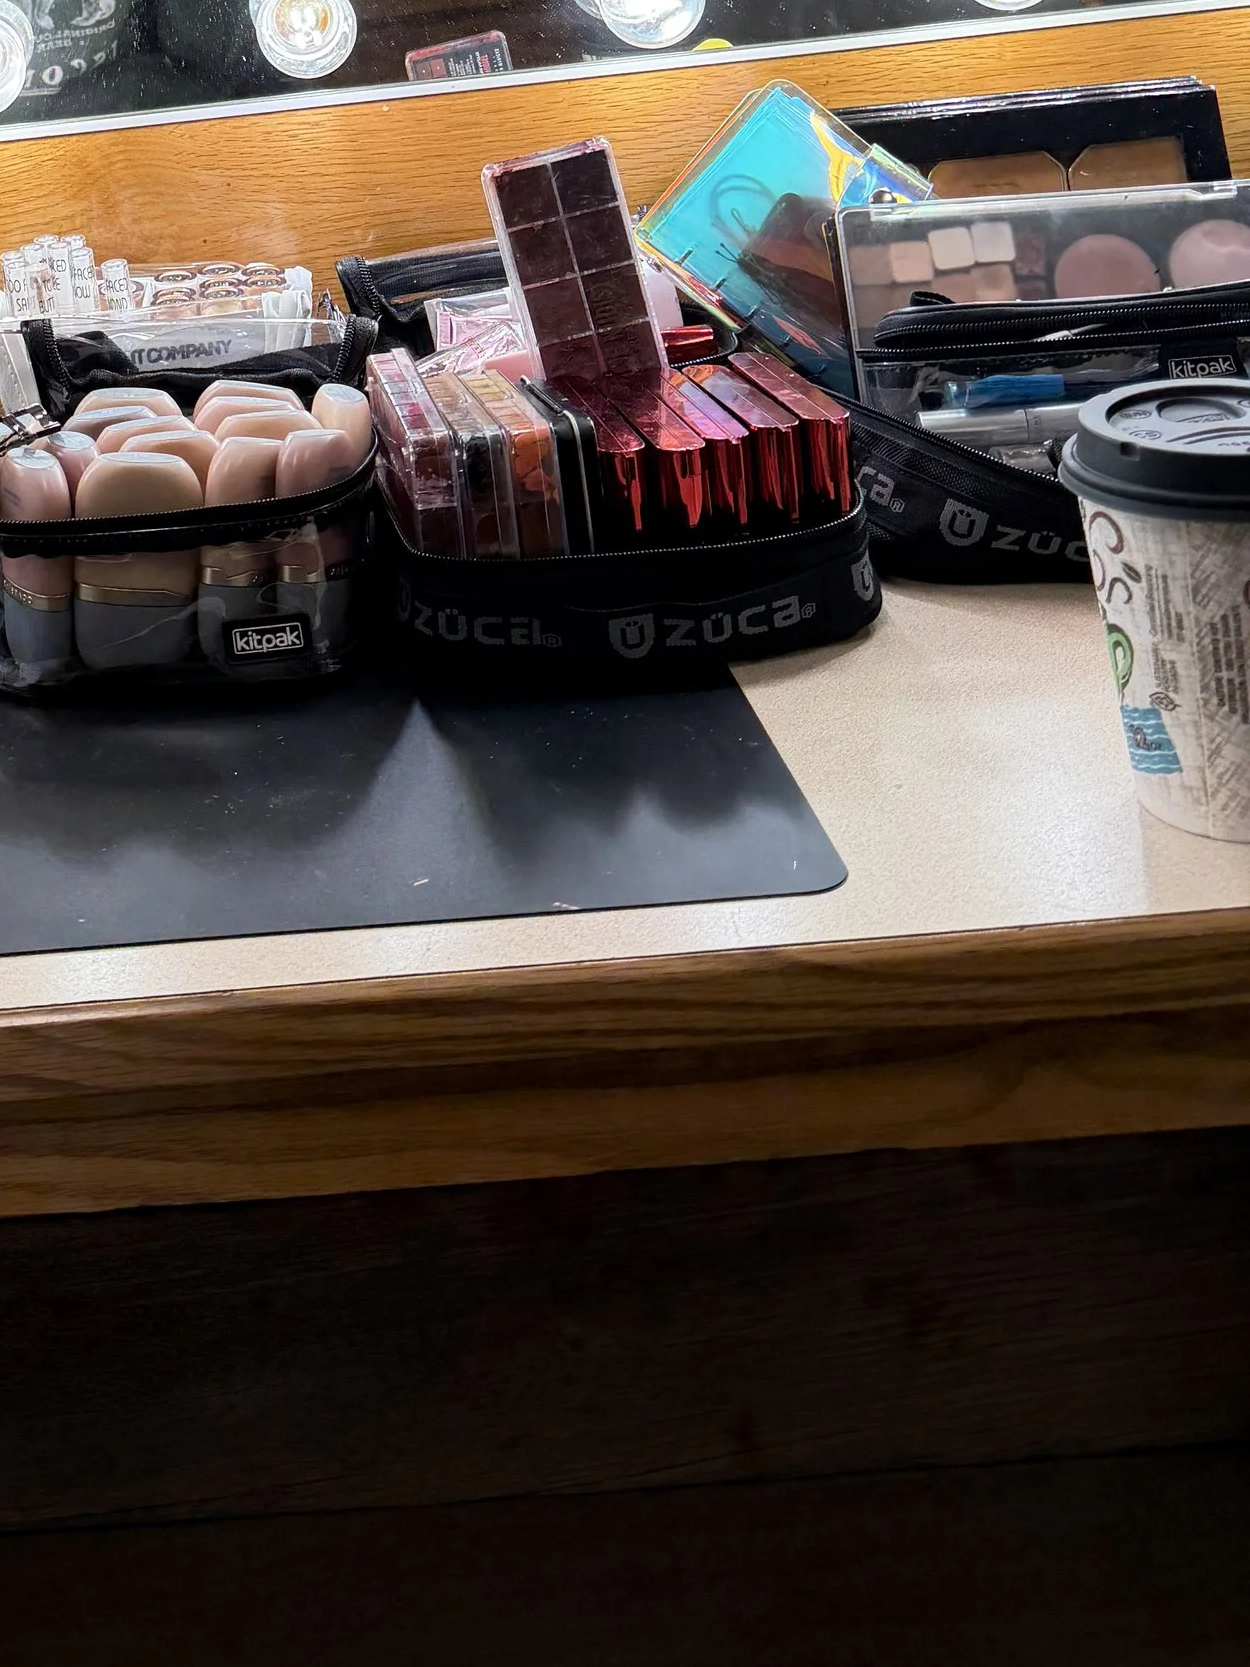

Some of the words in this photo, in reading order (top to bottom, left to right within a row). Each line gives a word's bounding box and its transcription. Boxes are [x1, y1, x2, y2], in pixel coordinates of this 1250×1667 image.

[146, 340, 233, 364] COMPANY
[1171, 358, 1234, 379] kitpak
[236, 625, 302, 653] kitpak
